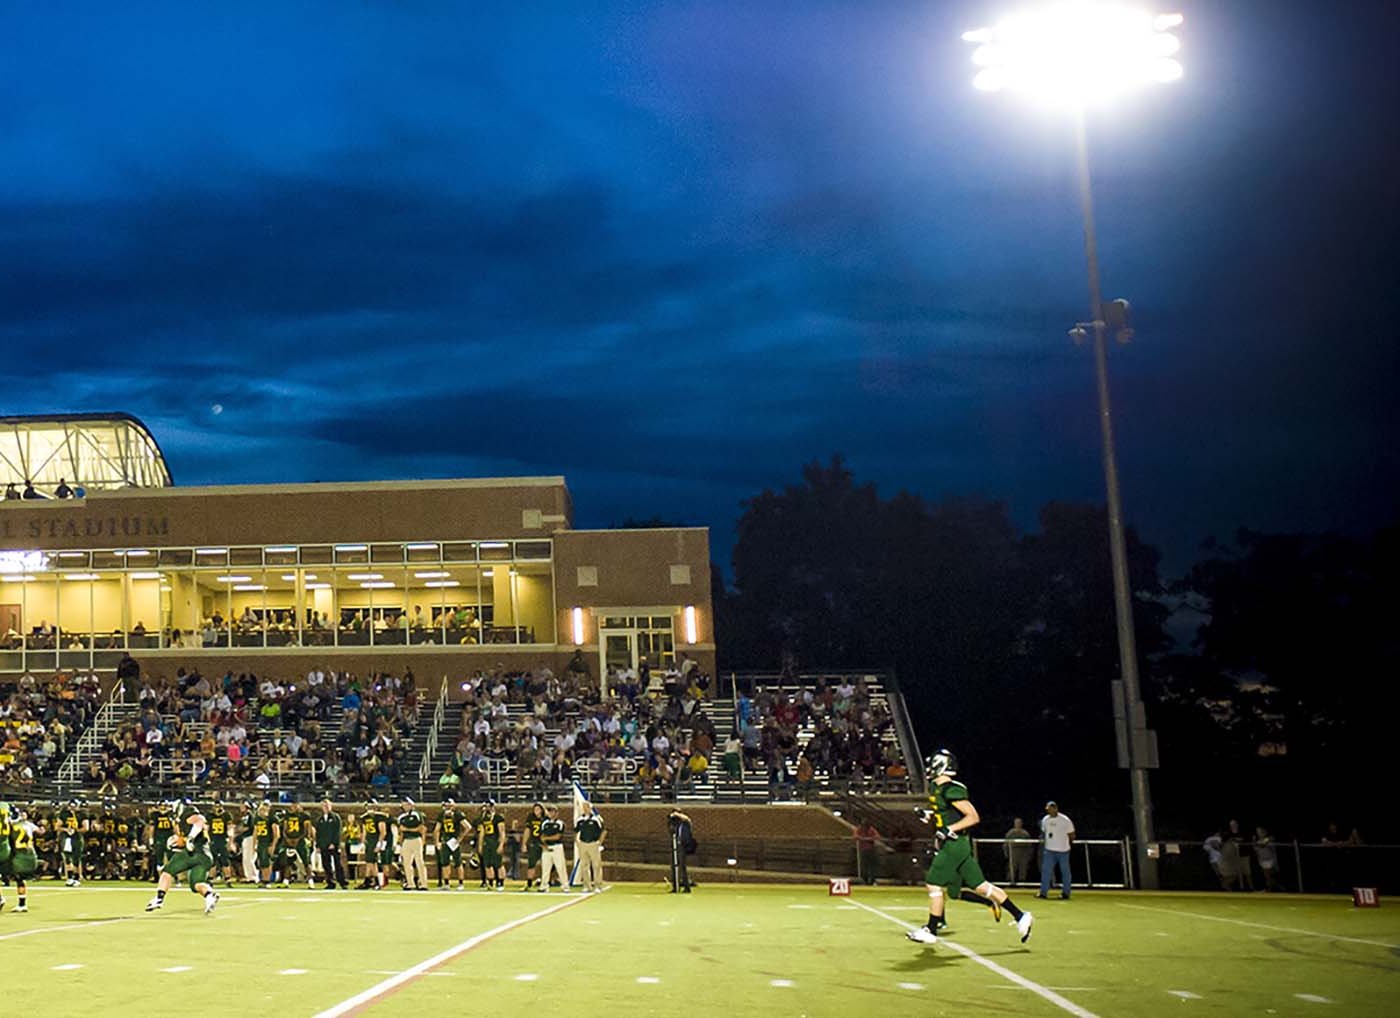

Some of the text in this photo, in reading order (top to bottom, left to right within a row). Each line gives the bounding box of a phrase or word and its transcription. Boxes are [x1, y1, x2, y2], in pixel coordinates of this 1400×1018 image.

[27, 516, 170, 538] STADIUM
[831, 879, 849, 895] 20
[1357, 887, 1376, 905] 10
